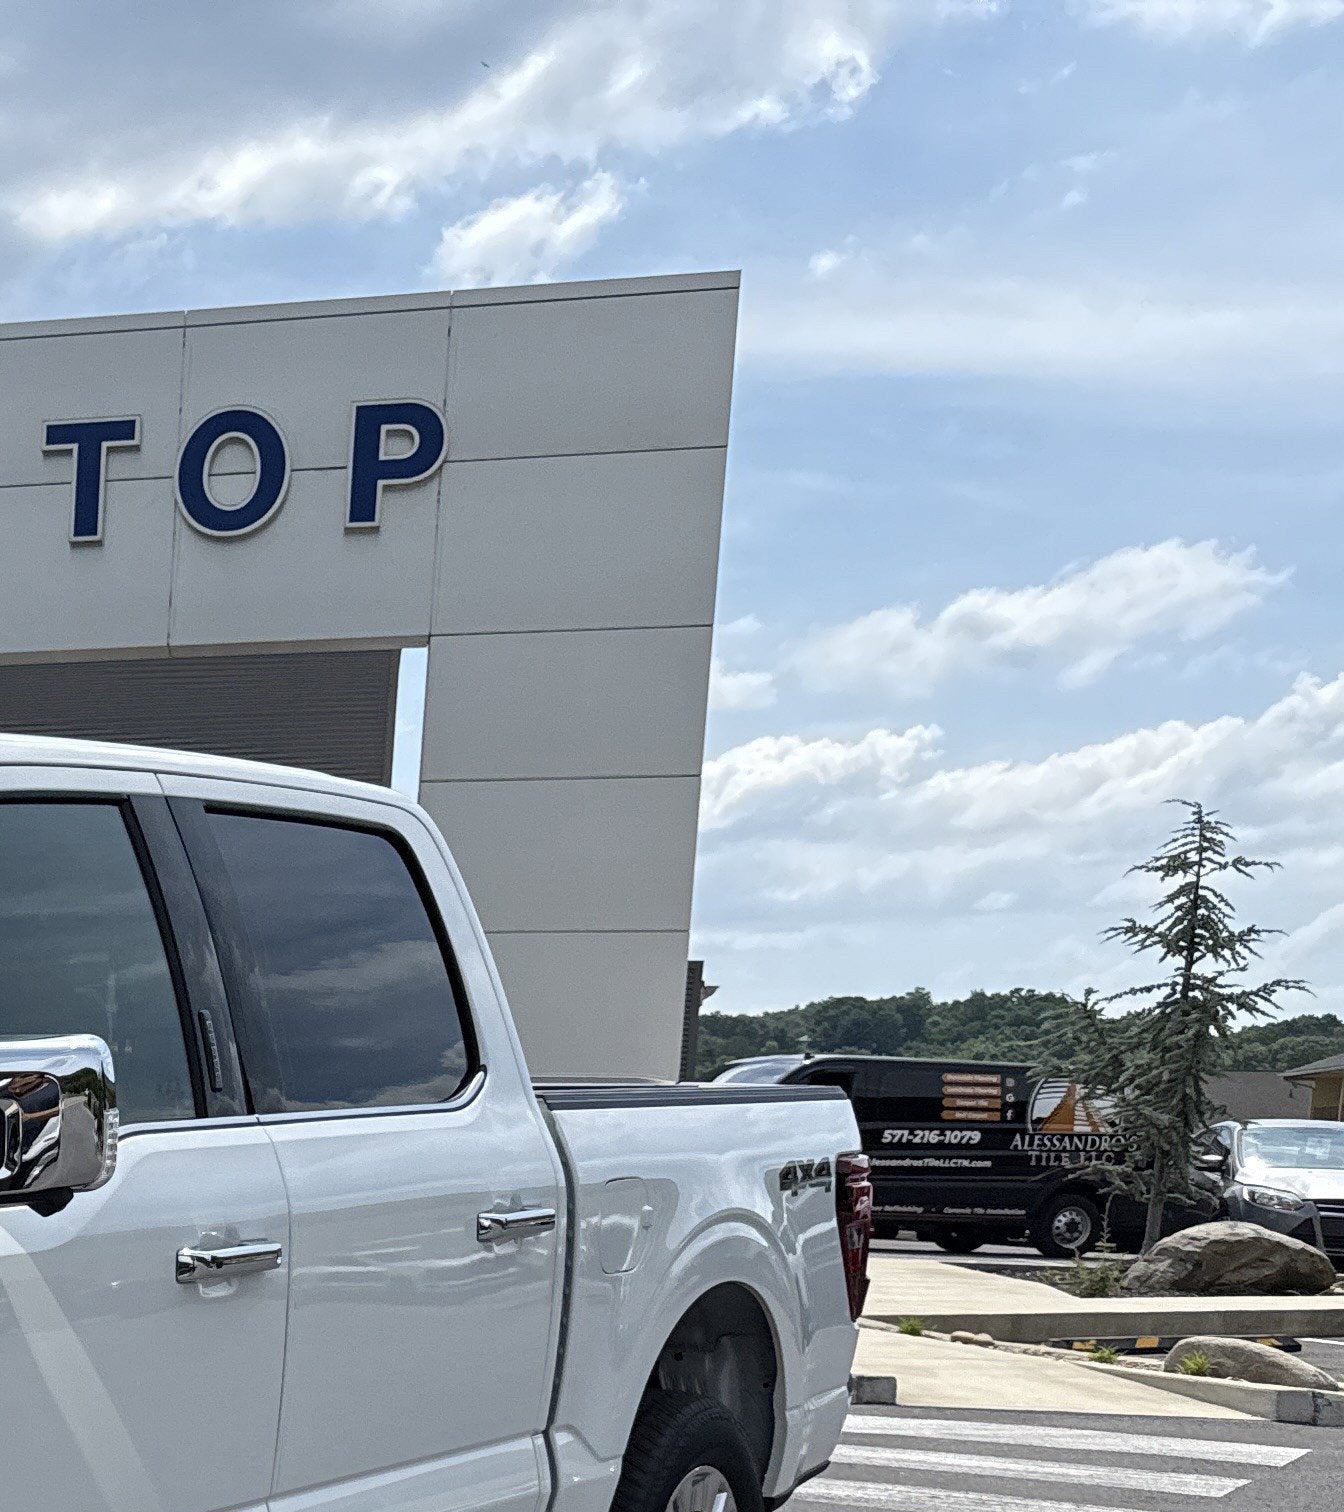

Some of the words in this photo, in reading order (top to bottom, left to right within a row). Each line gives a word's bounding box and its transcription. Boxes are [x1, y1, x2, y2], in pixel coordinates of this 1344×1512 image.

[41, 397, 450, 544] TOP
[881, 1129, 982, 1145] 571-216-1079
[1027, 1150, 1072, 1167] TILE
